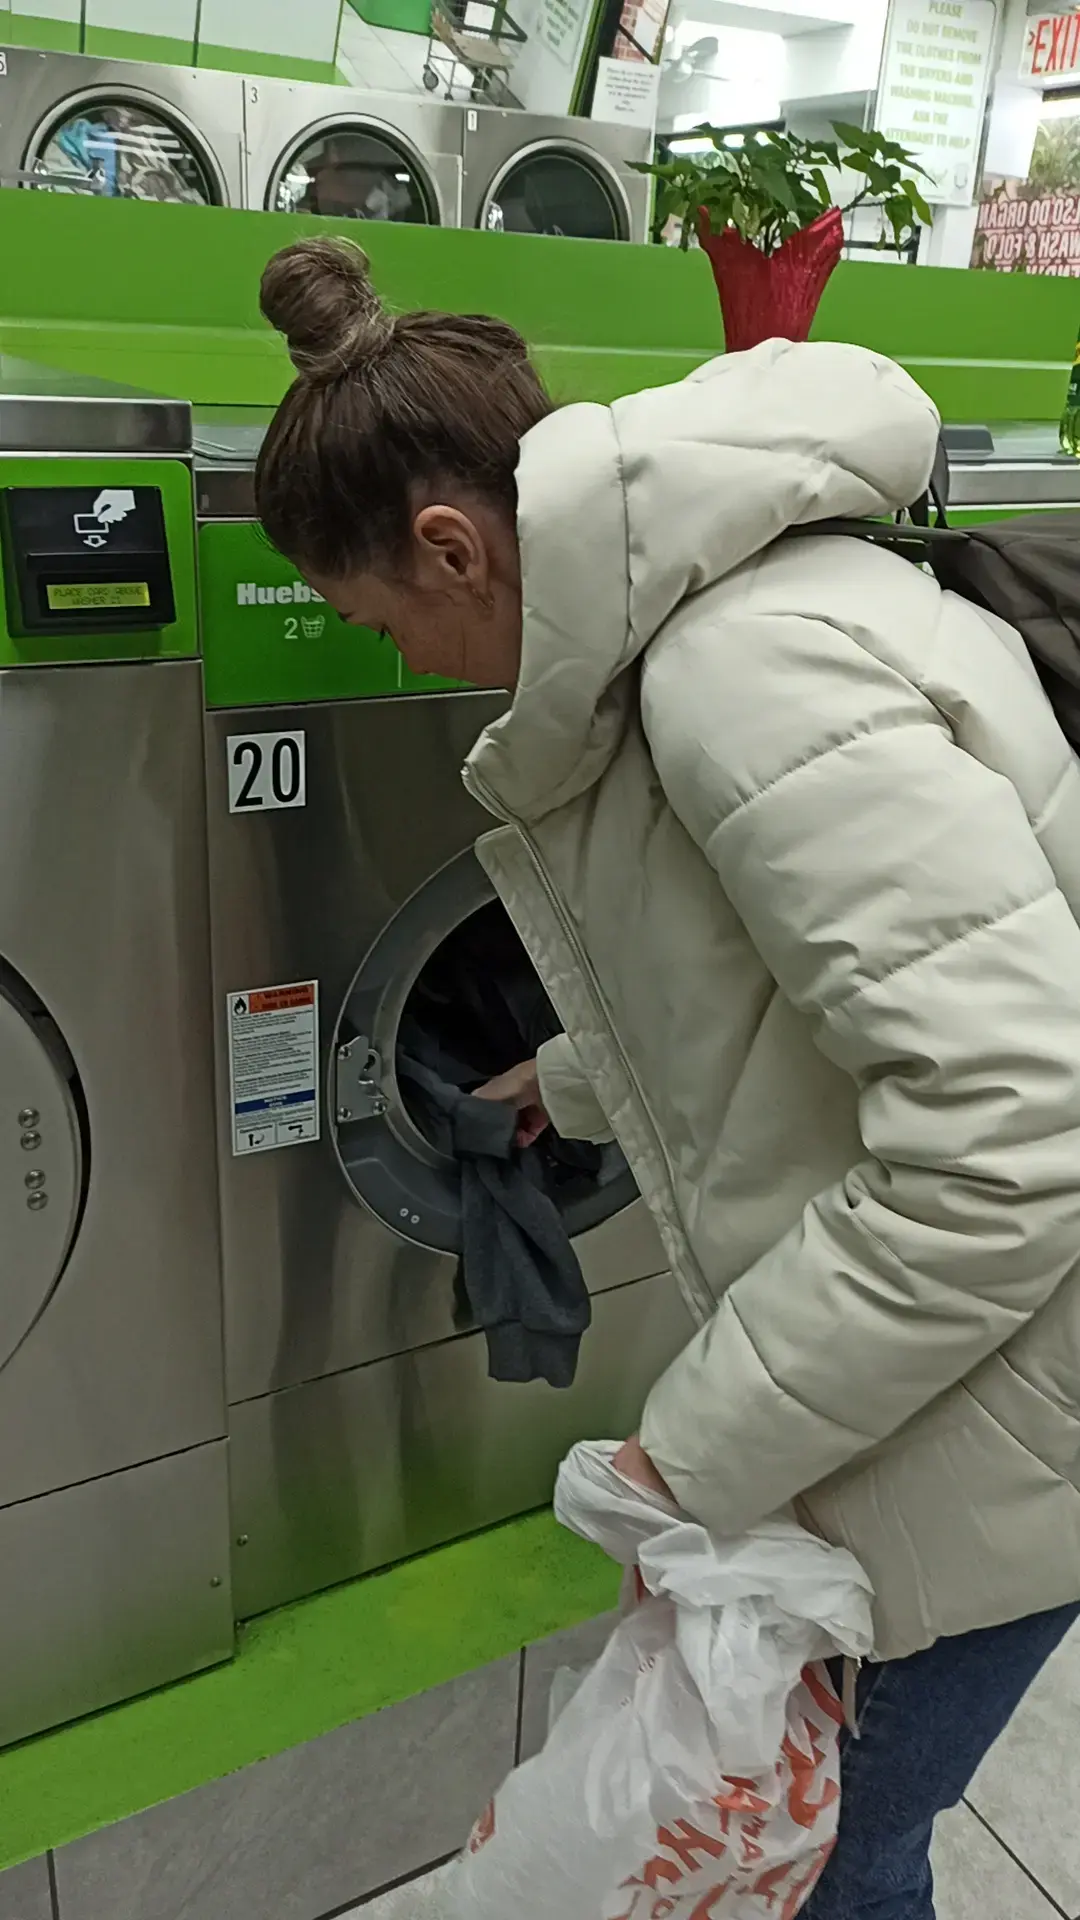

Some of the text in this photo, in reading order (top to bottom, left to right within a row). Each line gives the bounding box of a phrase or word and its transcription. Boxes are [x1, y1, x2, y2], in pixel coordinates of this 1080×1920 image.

[929, 1, 963, 18] PLEASE
[1031, 12, 1080, 74] EXIT
[251, 86, 258, 104] 3
[237, 581, 327, 605] Huebs
[284, 617, 298, 639] 2
[233, 737, 300, 807] 20
